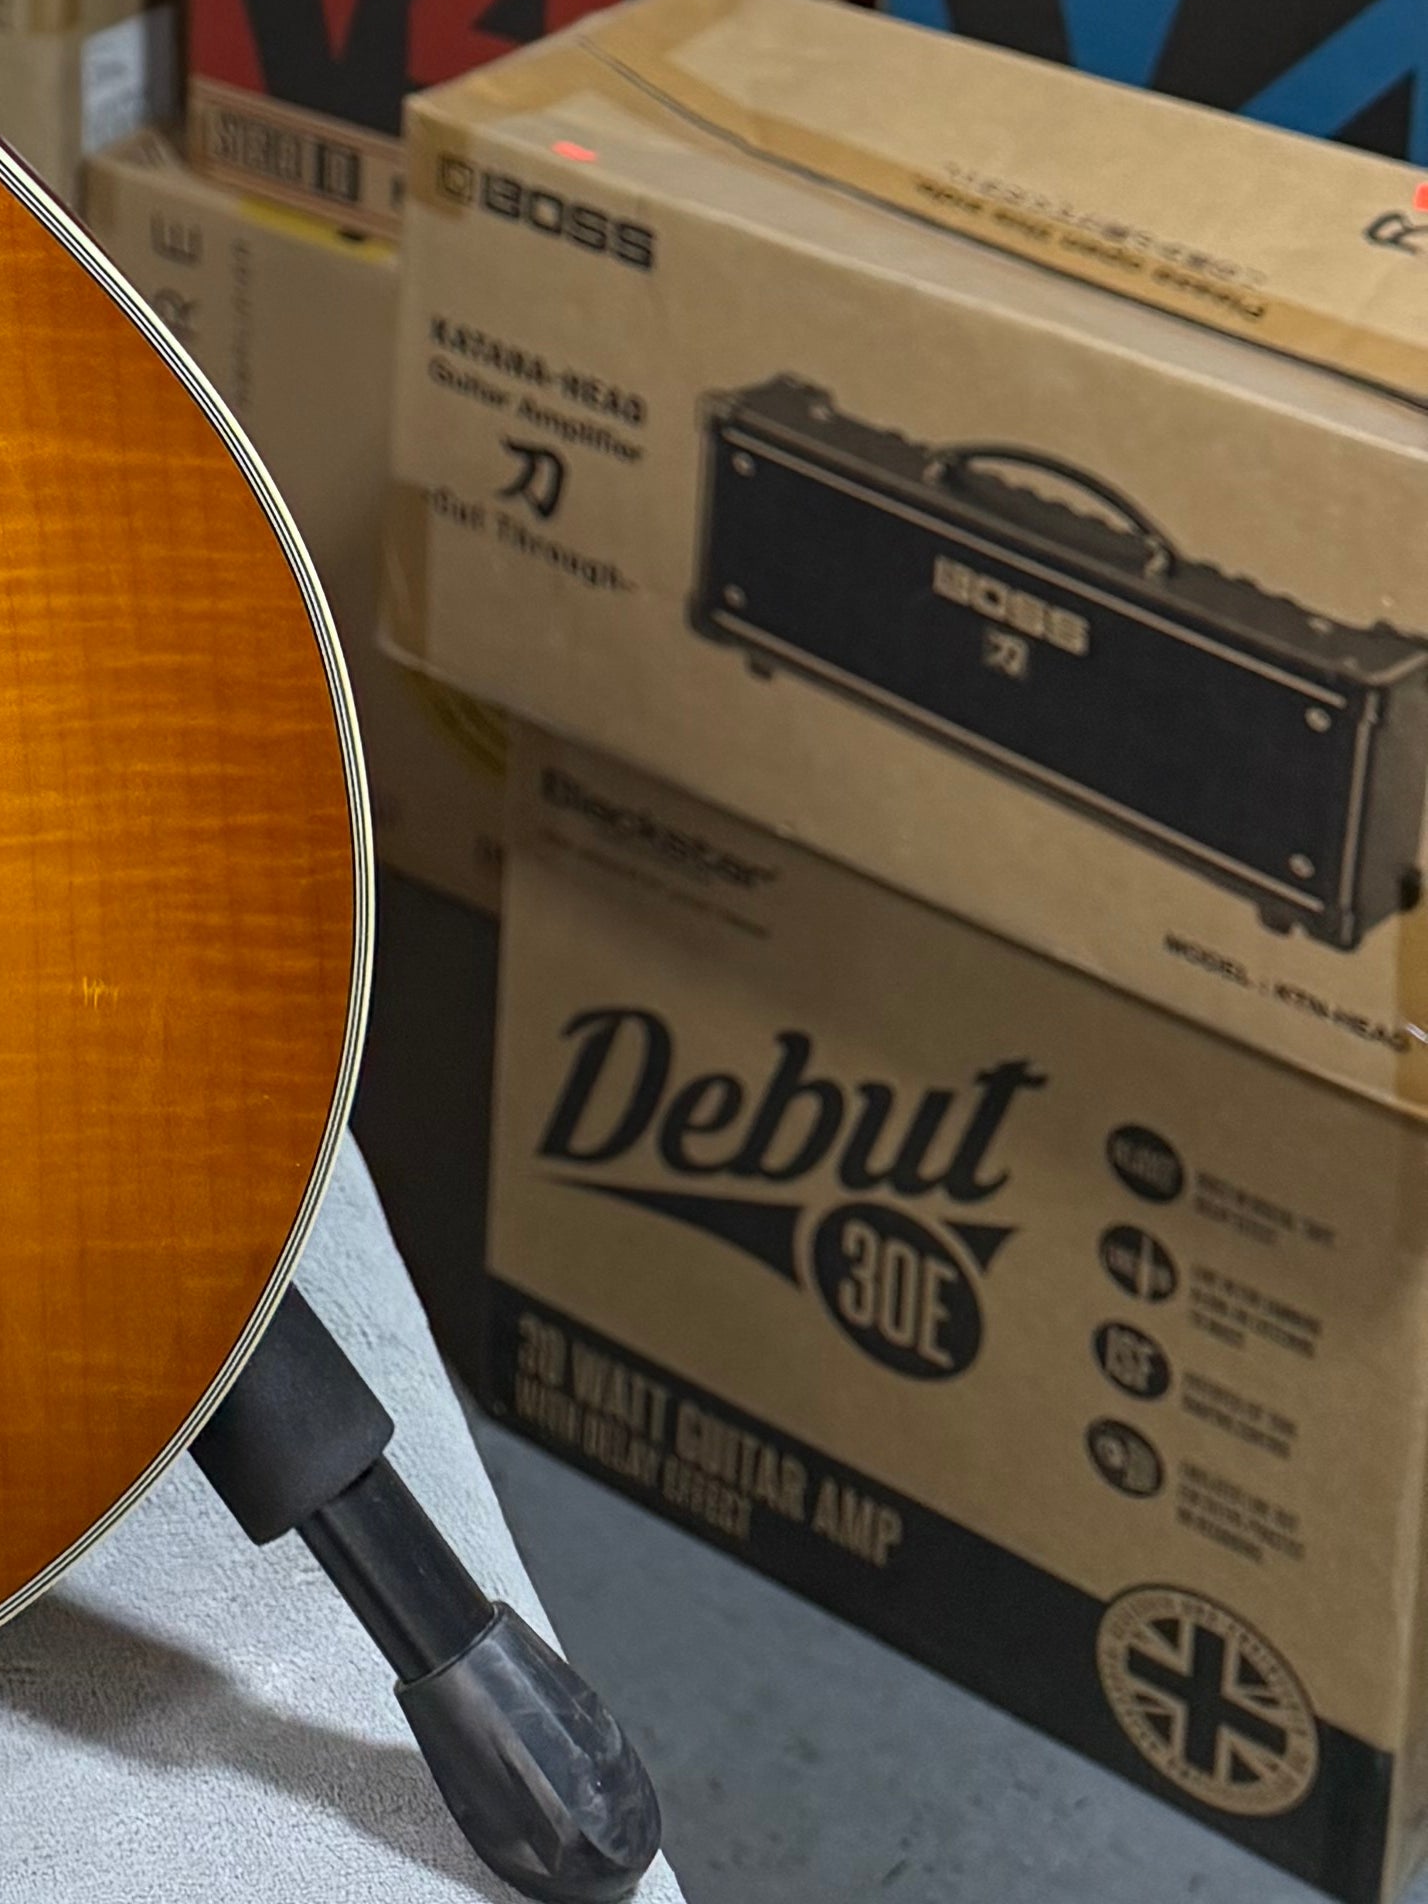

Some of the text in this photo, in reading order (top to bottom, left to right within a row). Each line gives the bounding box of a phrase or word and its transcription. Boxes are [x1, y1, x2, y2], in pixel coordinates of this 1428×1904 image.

[480, 169, 657, 272] BOSS
[428, 355, 643, 464] Guitar Amplifier
[931, 553, 1091, 658] BOSS
[538, 1005, 1049, 1202] Debut
[841, 1214, 957, 1372] 30E
[571, 1340, 670, 1444] WATT
[675, 1397, 808, 1523] GUITAR
[812, 1475, 904, 1569] AMP
